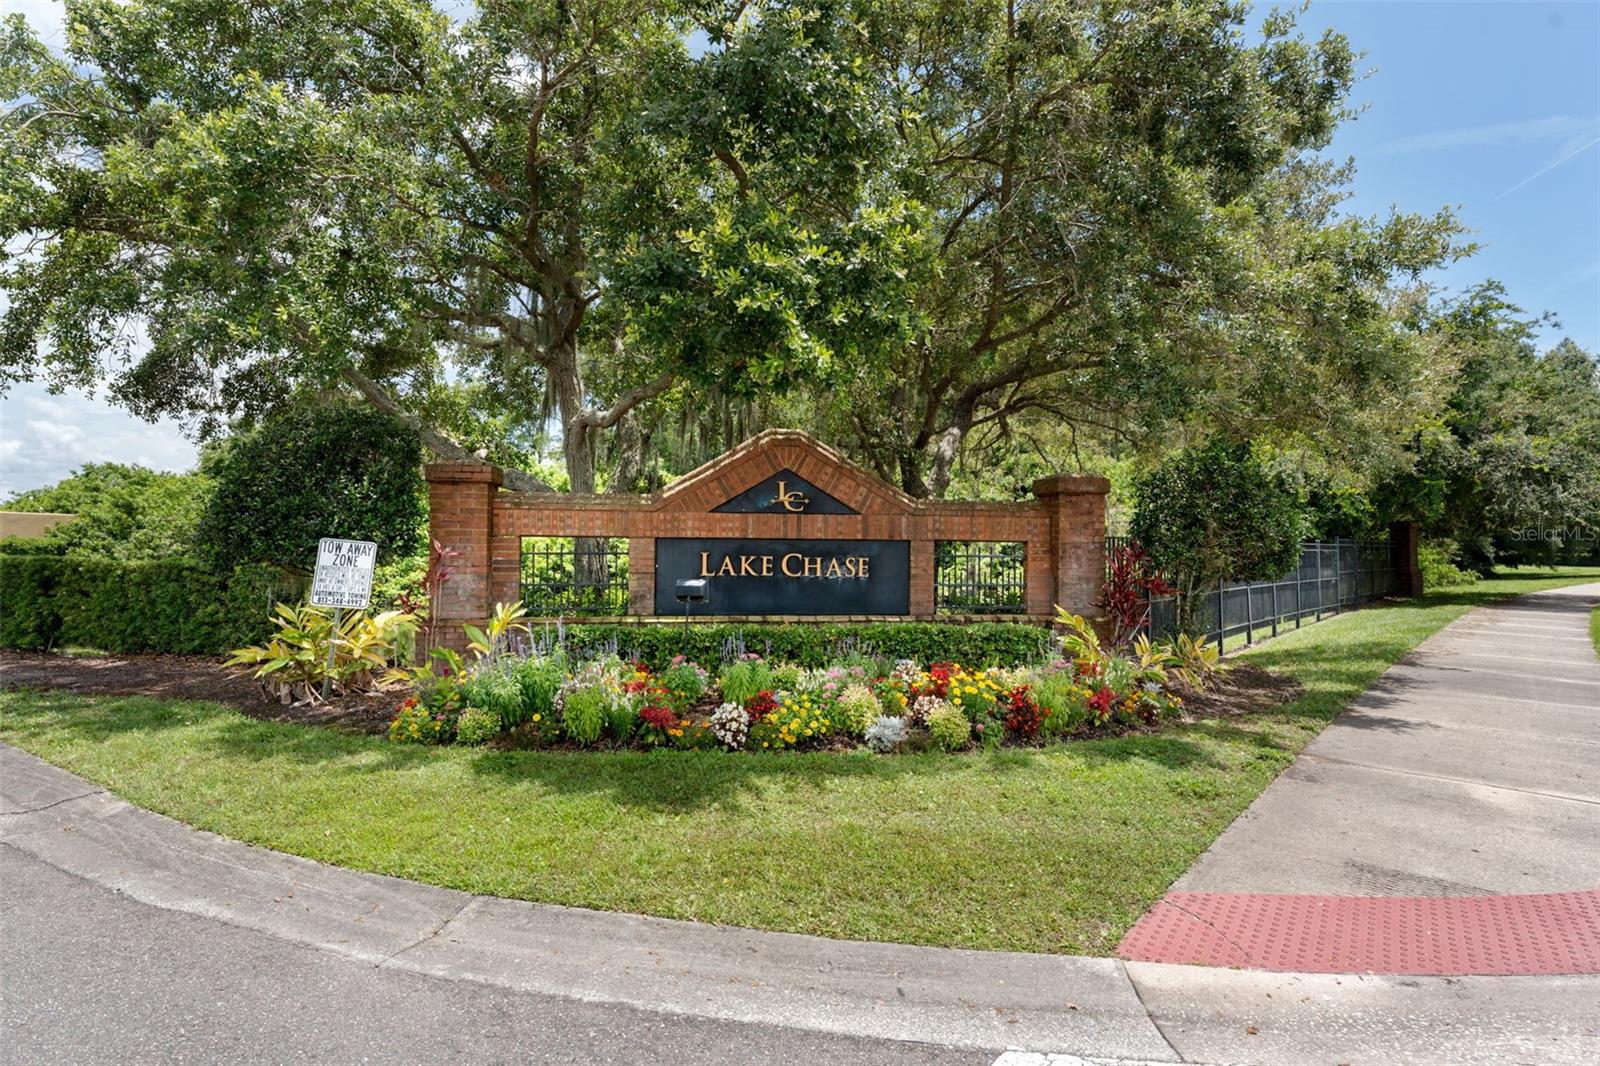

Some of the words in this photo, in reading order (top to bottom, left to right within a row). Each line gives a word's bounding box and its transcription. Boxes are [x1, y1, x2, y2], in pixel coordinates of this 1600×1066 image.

[323, 541, 343, 553] TOW
[347, 543, 373, 556] AWAY
[332, 554, 359, 567] ZONE
[700, 552, 774, 577] LAKE
[781, 553, 870, 578] CHASE
